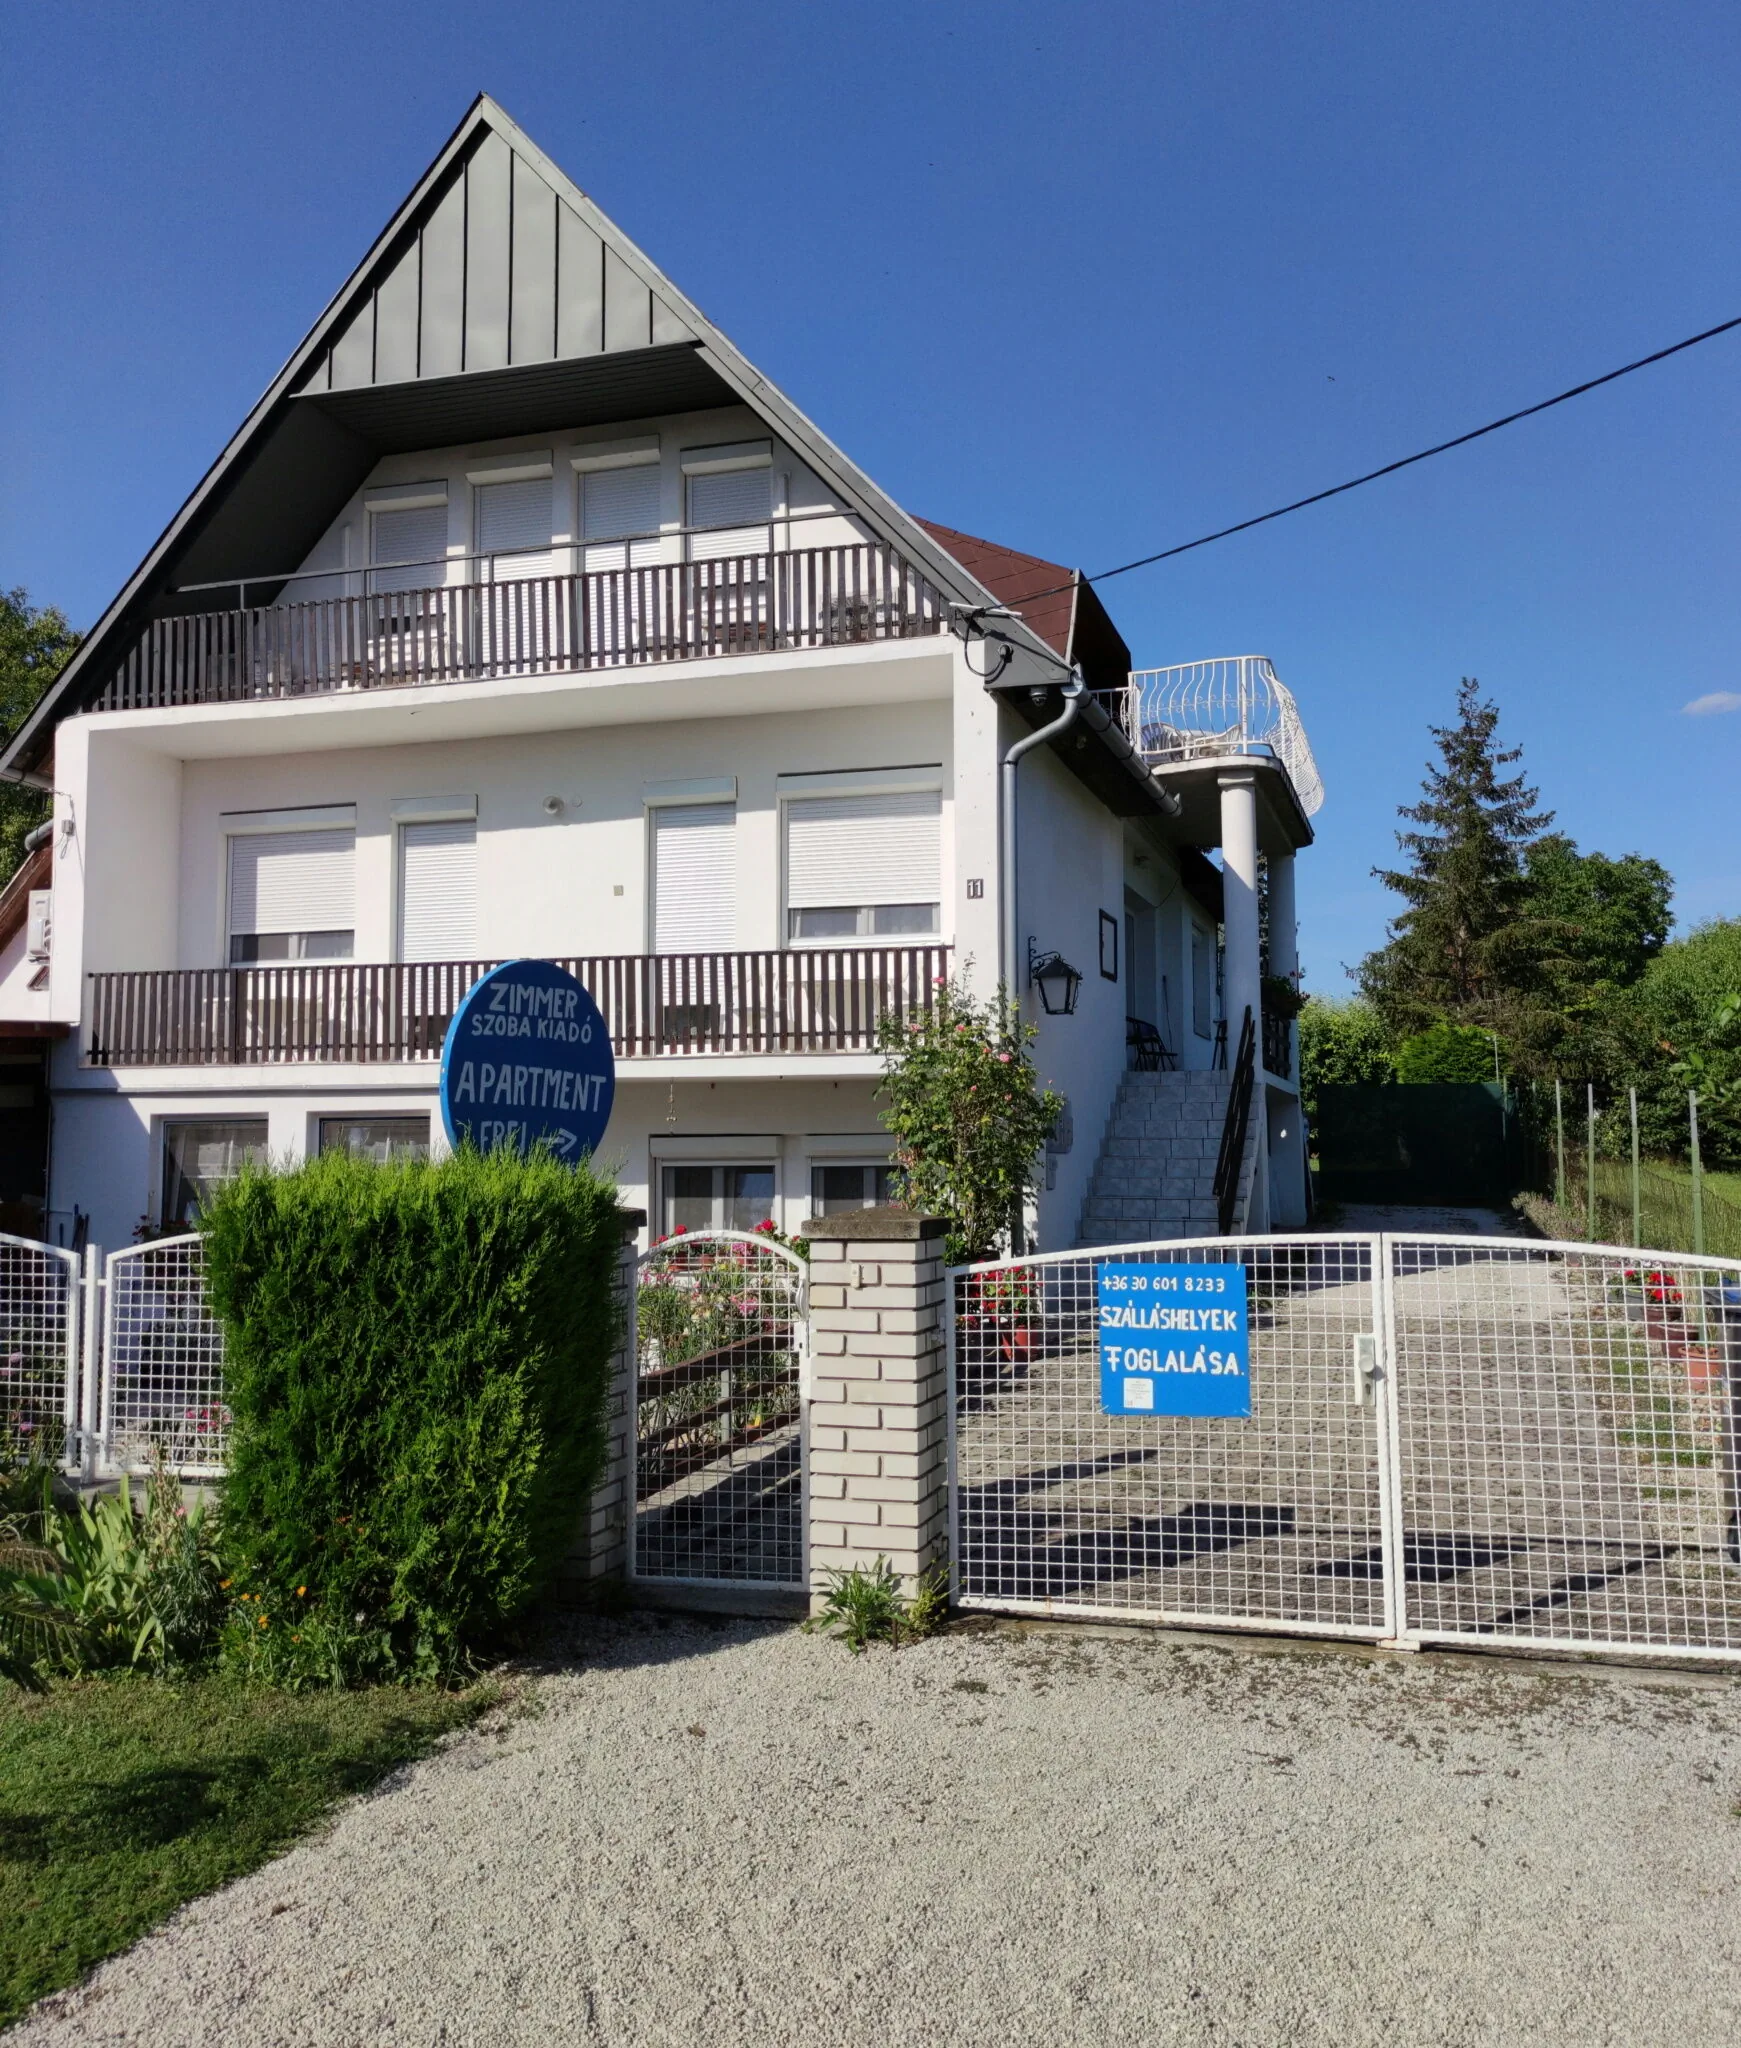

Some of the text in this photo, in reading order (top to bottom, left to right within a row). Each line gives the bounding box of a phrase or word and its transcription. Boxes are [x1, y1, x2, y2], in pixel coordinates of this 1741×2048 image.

[967, 880, 982, 897] 11
[489, 983, 578, 1019] ZIMMER
[471, 1013, 592, 1044] SZOBA KIADÓ
[454, 1061, 607, 1113] APARTMENT
[1102, 1275, 1225, 1292] +36 30 601 8233
[1100, 1299, 1237, 1331] SZÁLLÁSHELYEK
